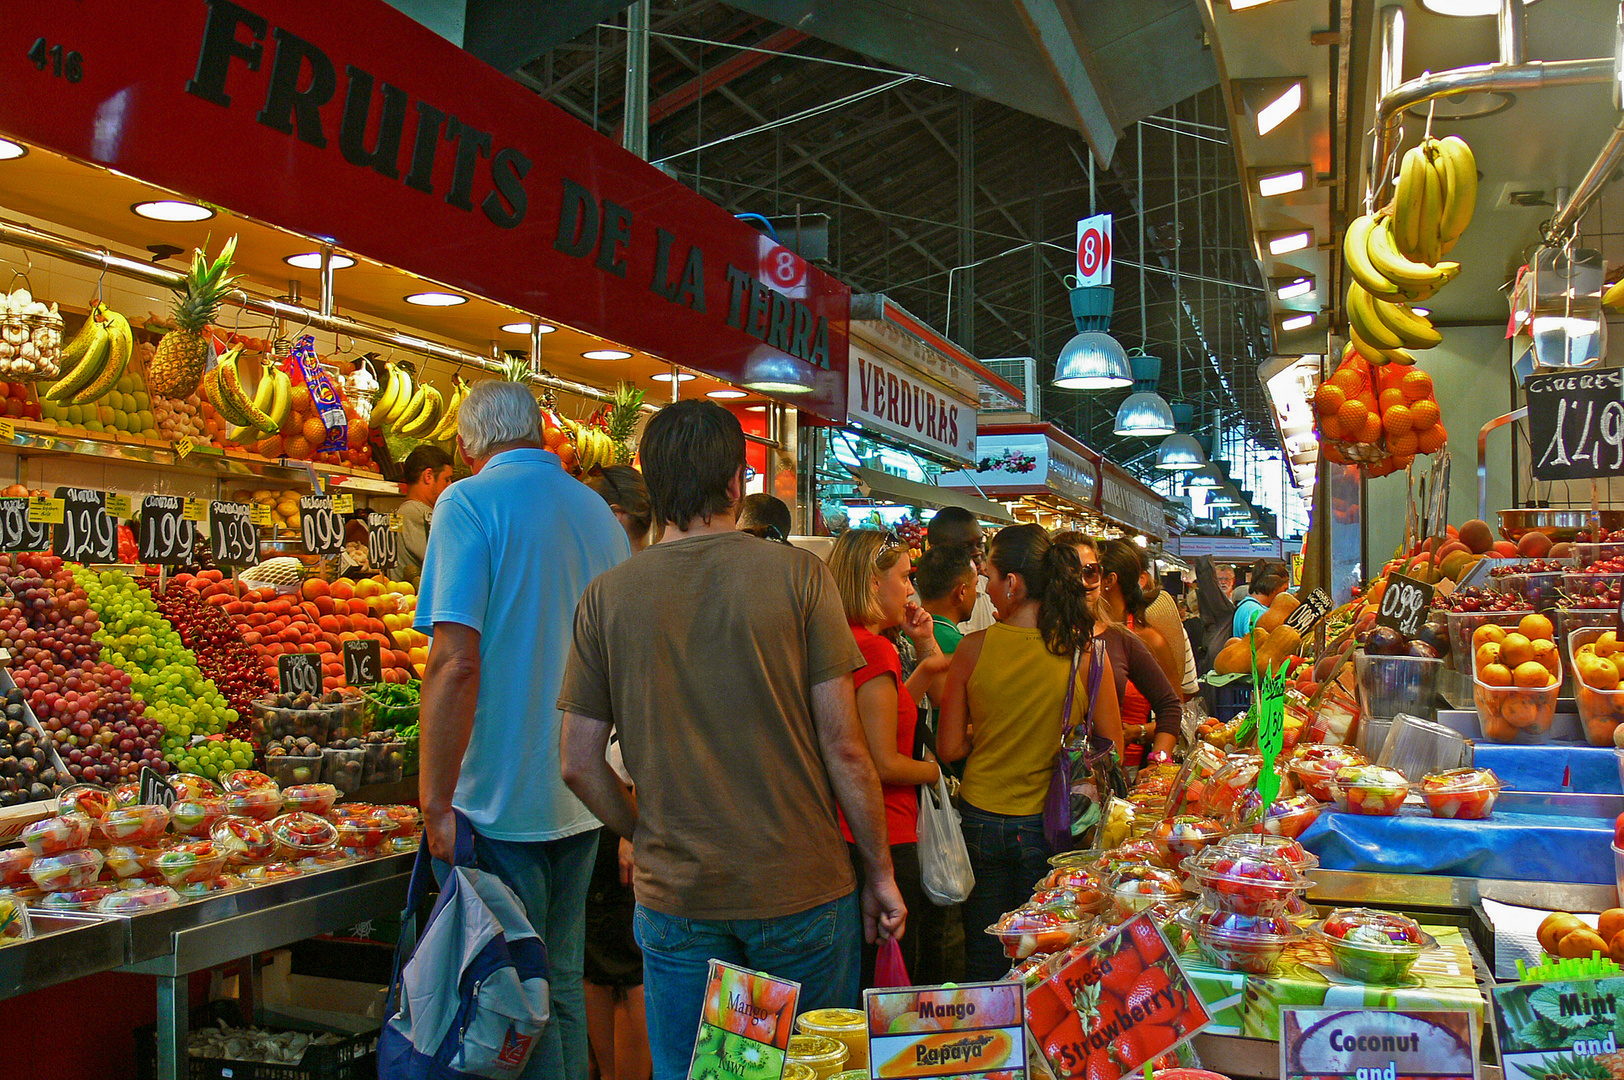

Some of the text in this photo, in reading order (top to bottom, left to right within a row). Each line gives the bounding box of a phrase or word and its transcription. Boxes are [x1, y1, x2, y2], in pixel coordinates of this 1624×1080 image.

[28, 37, 84, 83] 416
[185, 0, 830, 370] FRUITS DE LA TERRA
[1083, 235, 1096, 269] 8
[858, 357, 958, 447] VERDURAS
[1064, 959, 1114, 996] Fresa
[726, 991, 769, 1026] Mango
[918, 1001, 976, 1020] Mango
[1559, 993, 1617, 1017] Mint
[1060, 984, 1177, 1068] Strawberry
[1329, 1028, 1420, 1052] Coconut
[915, 1044, 982, 1065] Papaya
[1572, 1031, 1618, 1056] and
[1355, 1060, 1397, 1080] and
